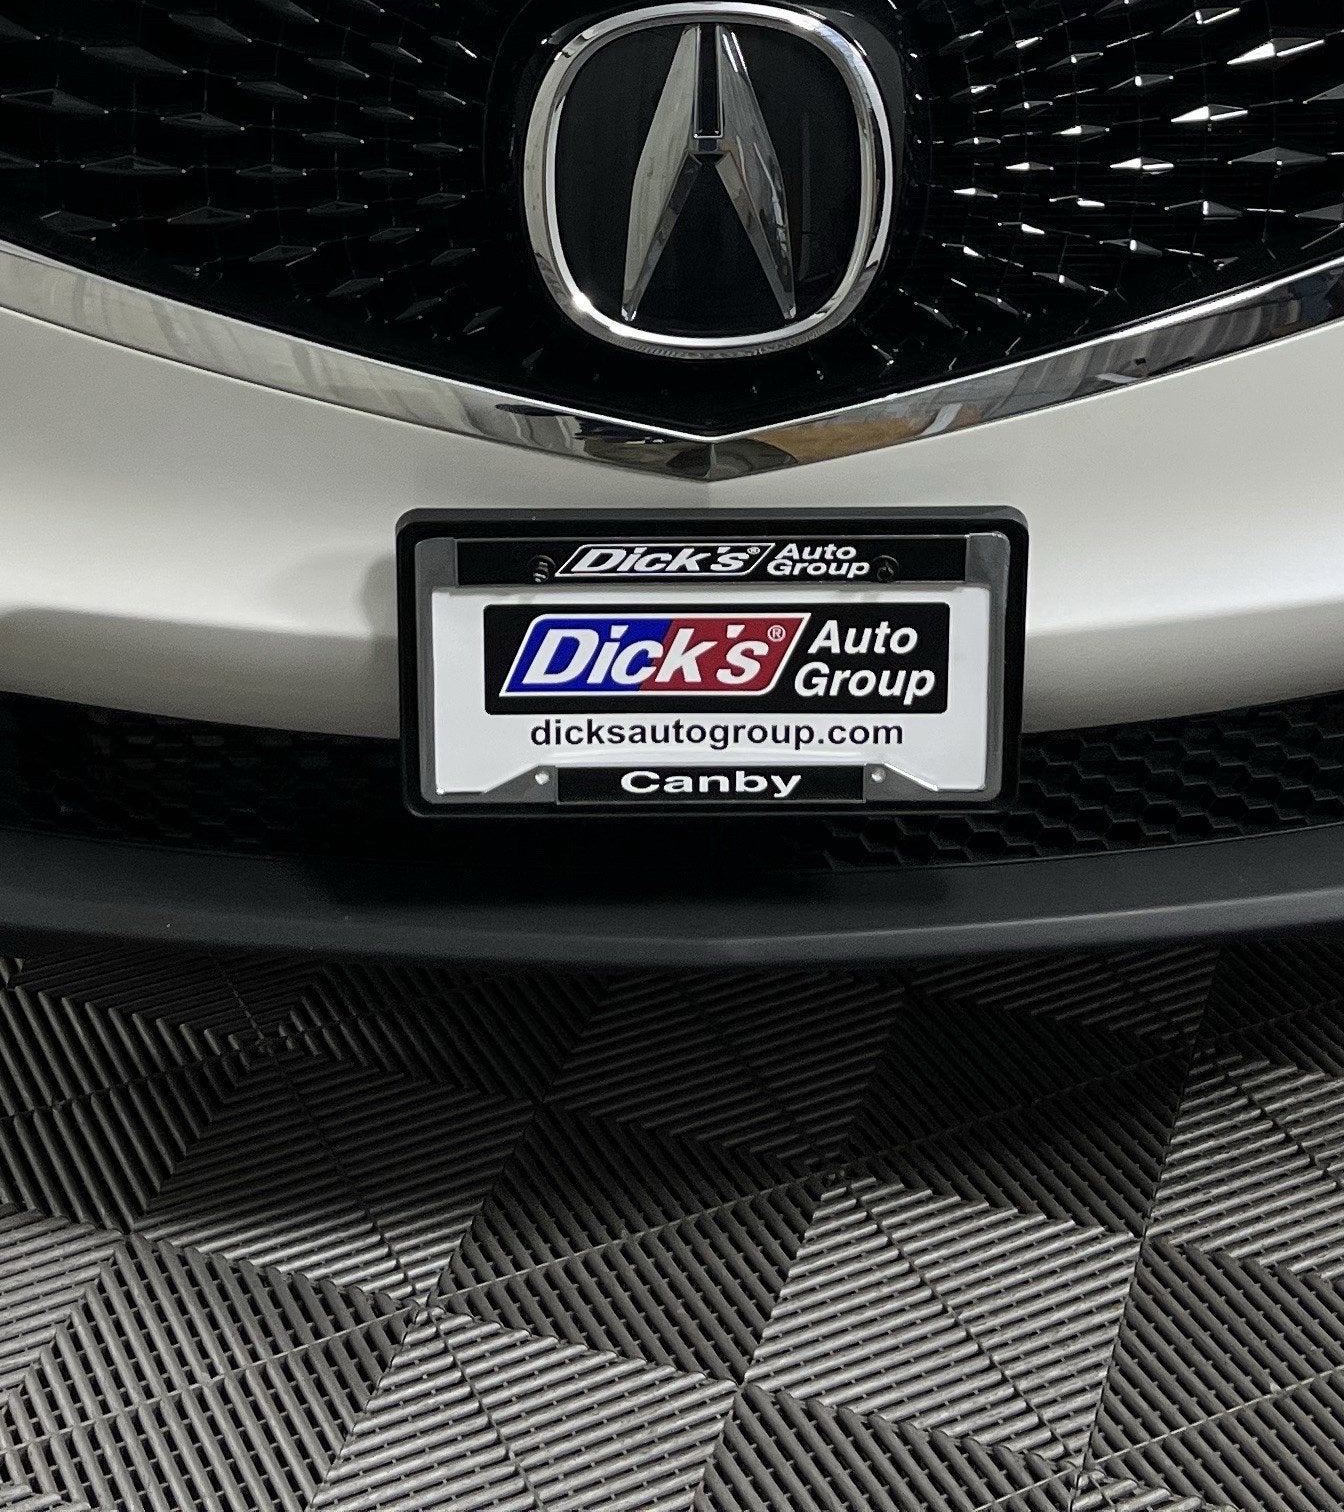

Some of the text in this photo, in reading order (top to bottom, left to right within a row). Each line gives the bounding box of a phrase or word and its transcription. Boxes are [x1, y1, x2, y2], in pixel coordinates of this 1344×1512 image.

[570, 546, 751, 572] Dick's
[774, 543, 856, 560] Auto
[767, 559, 871, 579] Group
[808, 620, 918, 656] Auto
[521, 624, 769, 685] Dick's
[794, 662, 936, 705] Group
[530, 718, 904, 751] dicksautogroup.com
[619, 770, 802, 799] Canby
